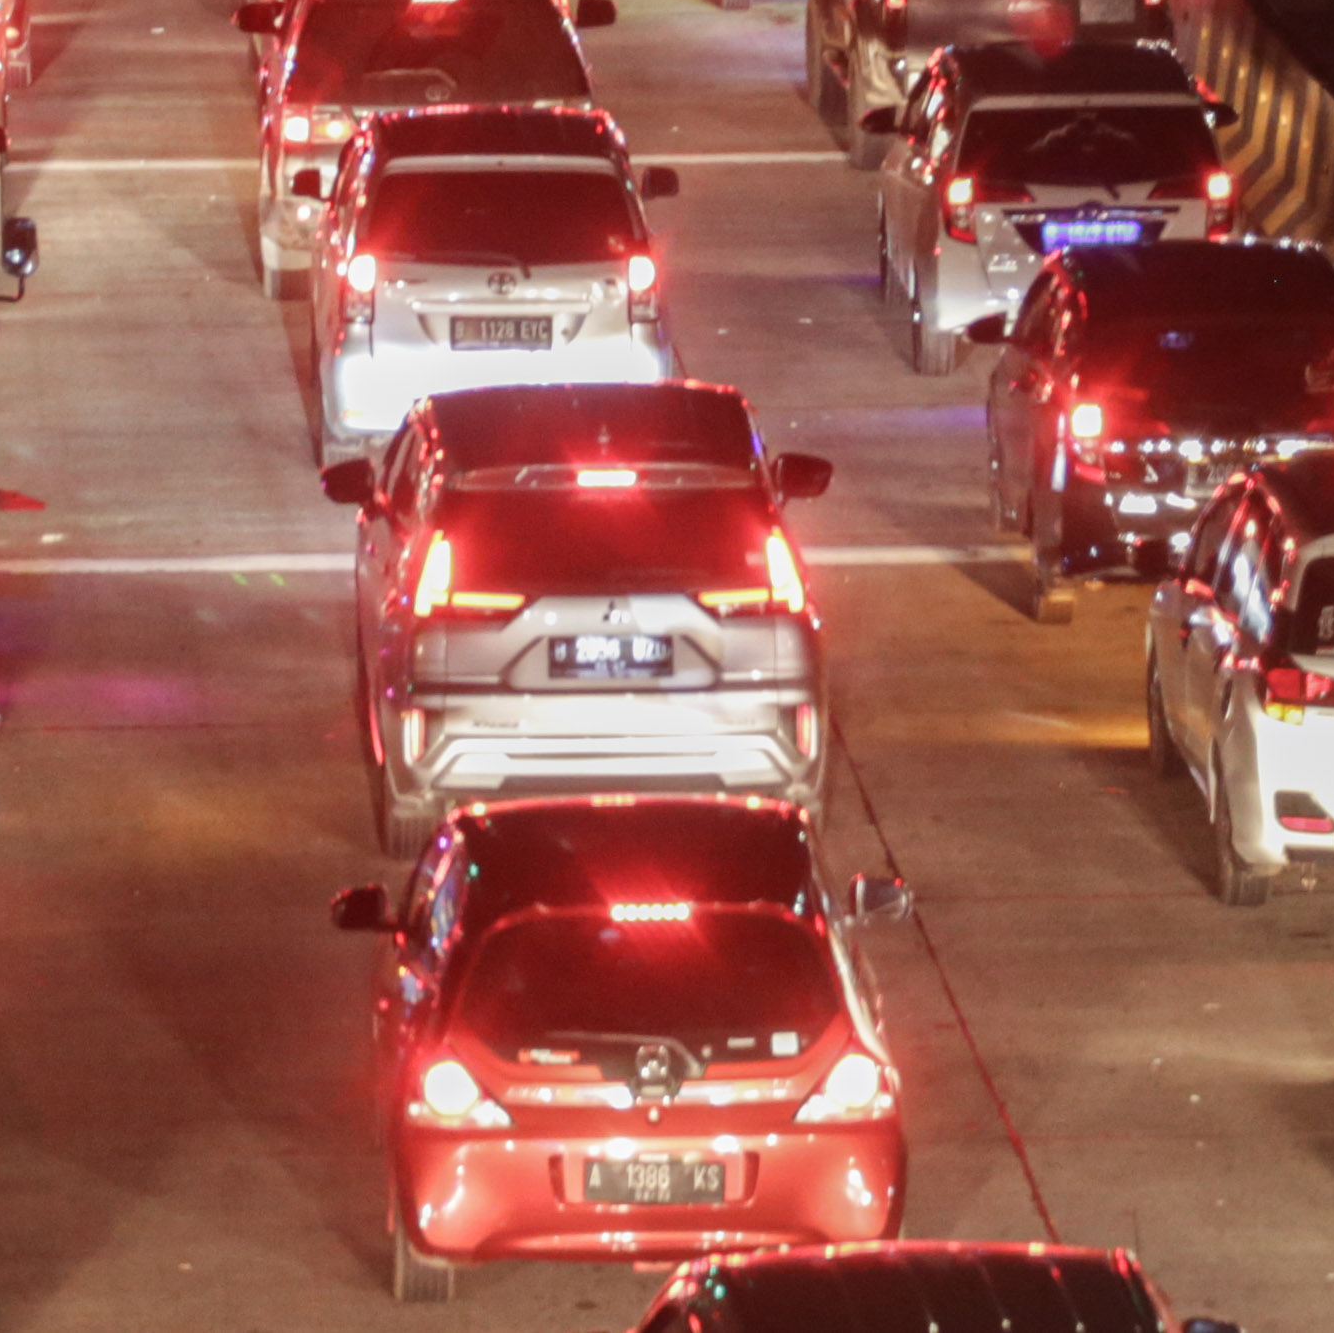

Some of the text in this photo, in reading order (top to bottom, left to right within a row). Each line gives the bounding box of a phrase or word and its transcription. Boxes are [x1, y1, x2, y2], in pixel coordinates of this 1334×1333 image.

[588, 1161, 720, 1192] A 1386 KS
